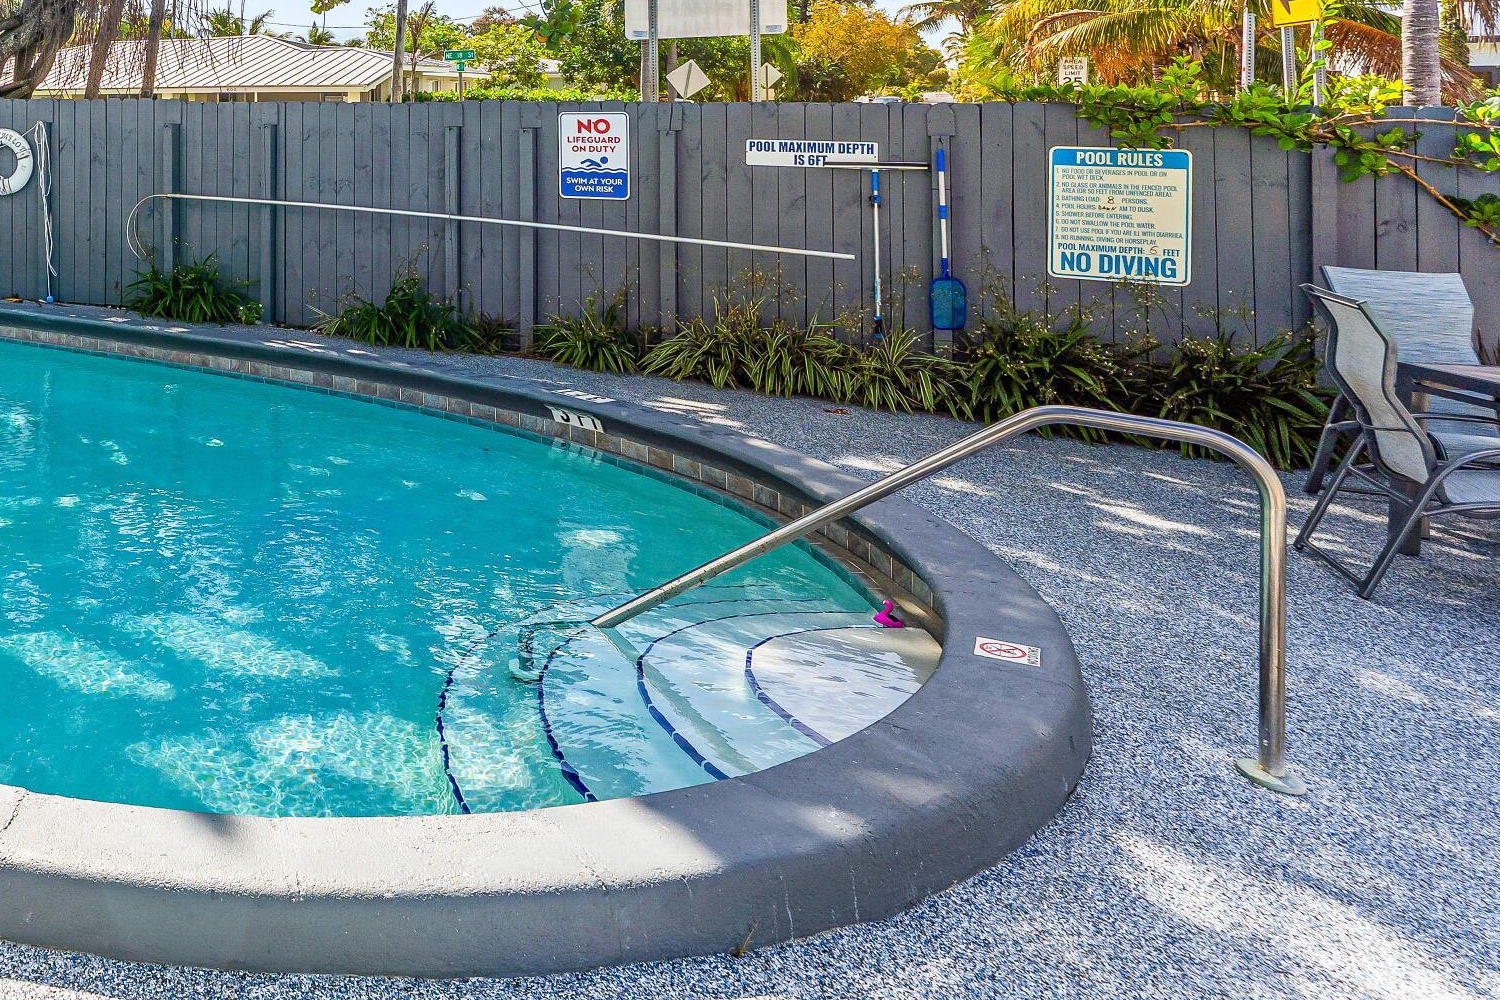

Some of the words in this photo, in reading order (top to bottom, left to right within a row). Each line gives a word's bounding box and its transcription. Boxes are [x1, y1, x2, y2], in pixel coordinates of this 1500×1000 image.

[577, 119, 610, 134] NO
[749, 141, 776, 152] POOL
[779, 142, 834, 153] MAXIMUM
[838, 143, 874, 154] DEPTH
[794, 155, 804, 165] IS
[808, 155, 828, 166] 6FT
[1077, 152, 1113, 165] POOL
[1118, 152, 1163, 167] RULES
[1107, 196, 1115, 204] 8
[1079, 244, 1116, 253] MAXIMUM
[1120, 246, 1145, 254] DEPTH:
[1163, 249, 1180, 257] FEET
[1061, 252, 1091, 272] NO
[1099, 254, 1177, 278] DIVING
